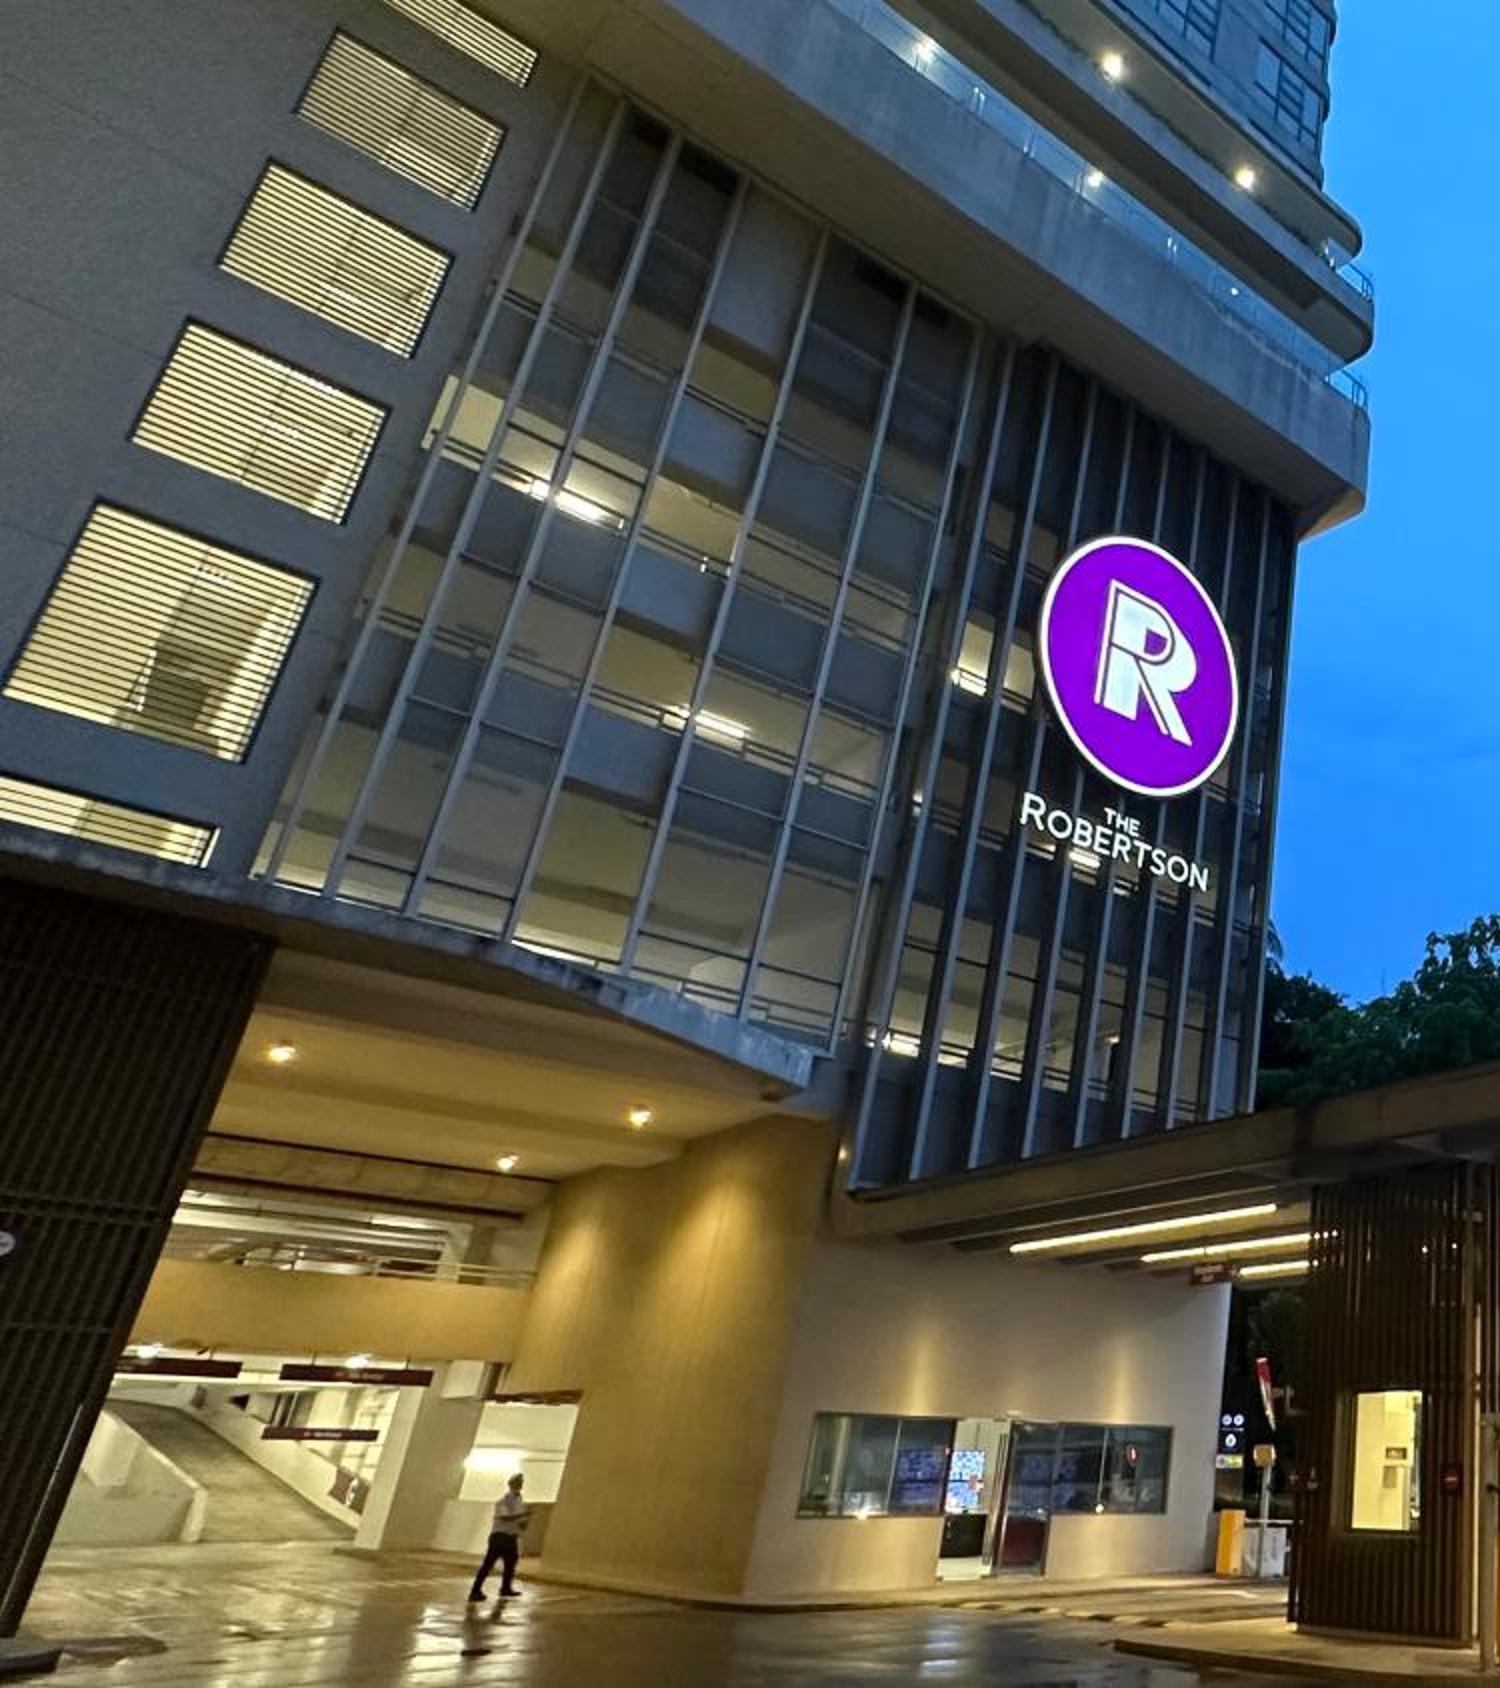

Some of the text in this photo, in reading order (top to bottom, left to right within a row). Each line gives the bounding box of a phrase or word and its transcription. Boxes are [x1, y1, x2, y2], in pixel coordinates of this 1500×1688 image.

[1094, 578, 1197, 747] R
[1019, 791, 1209, 893] ROBERTSON
[1103, 807, 1141, 837] THE
